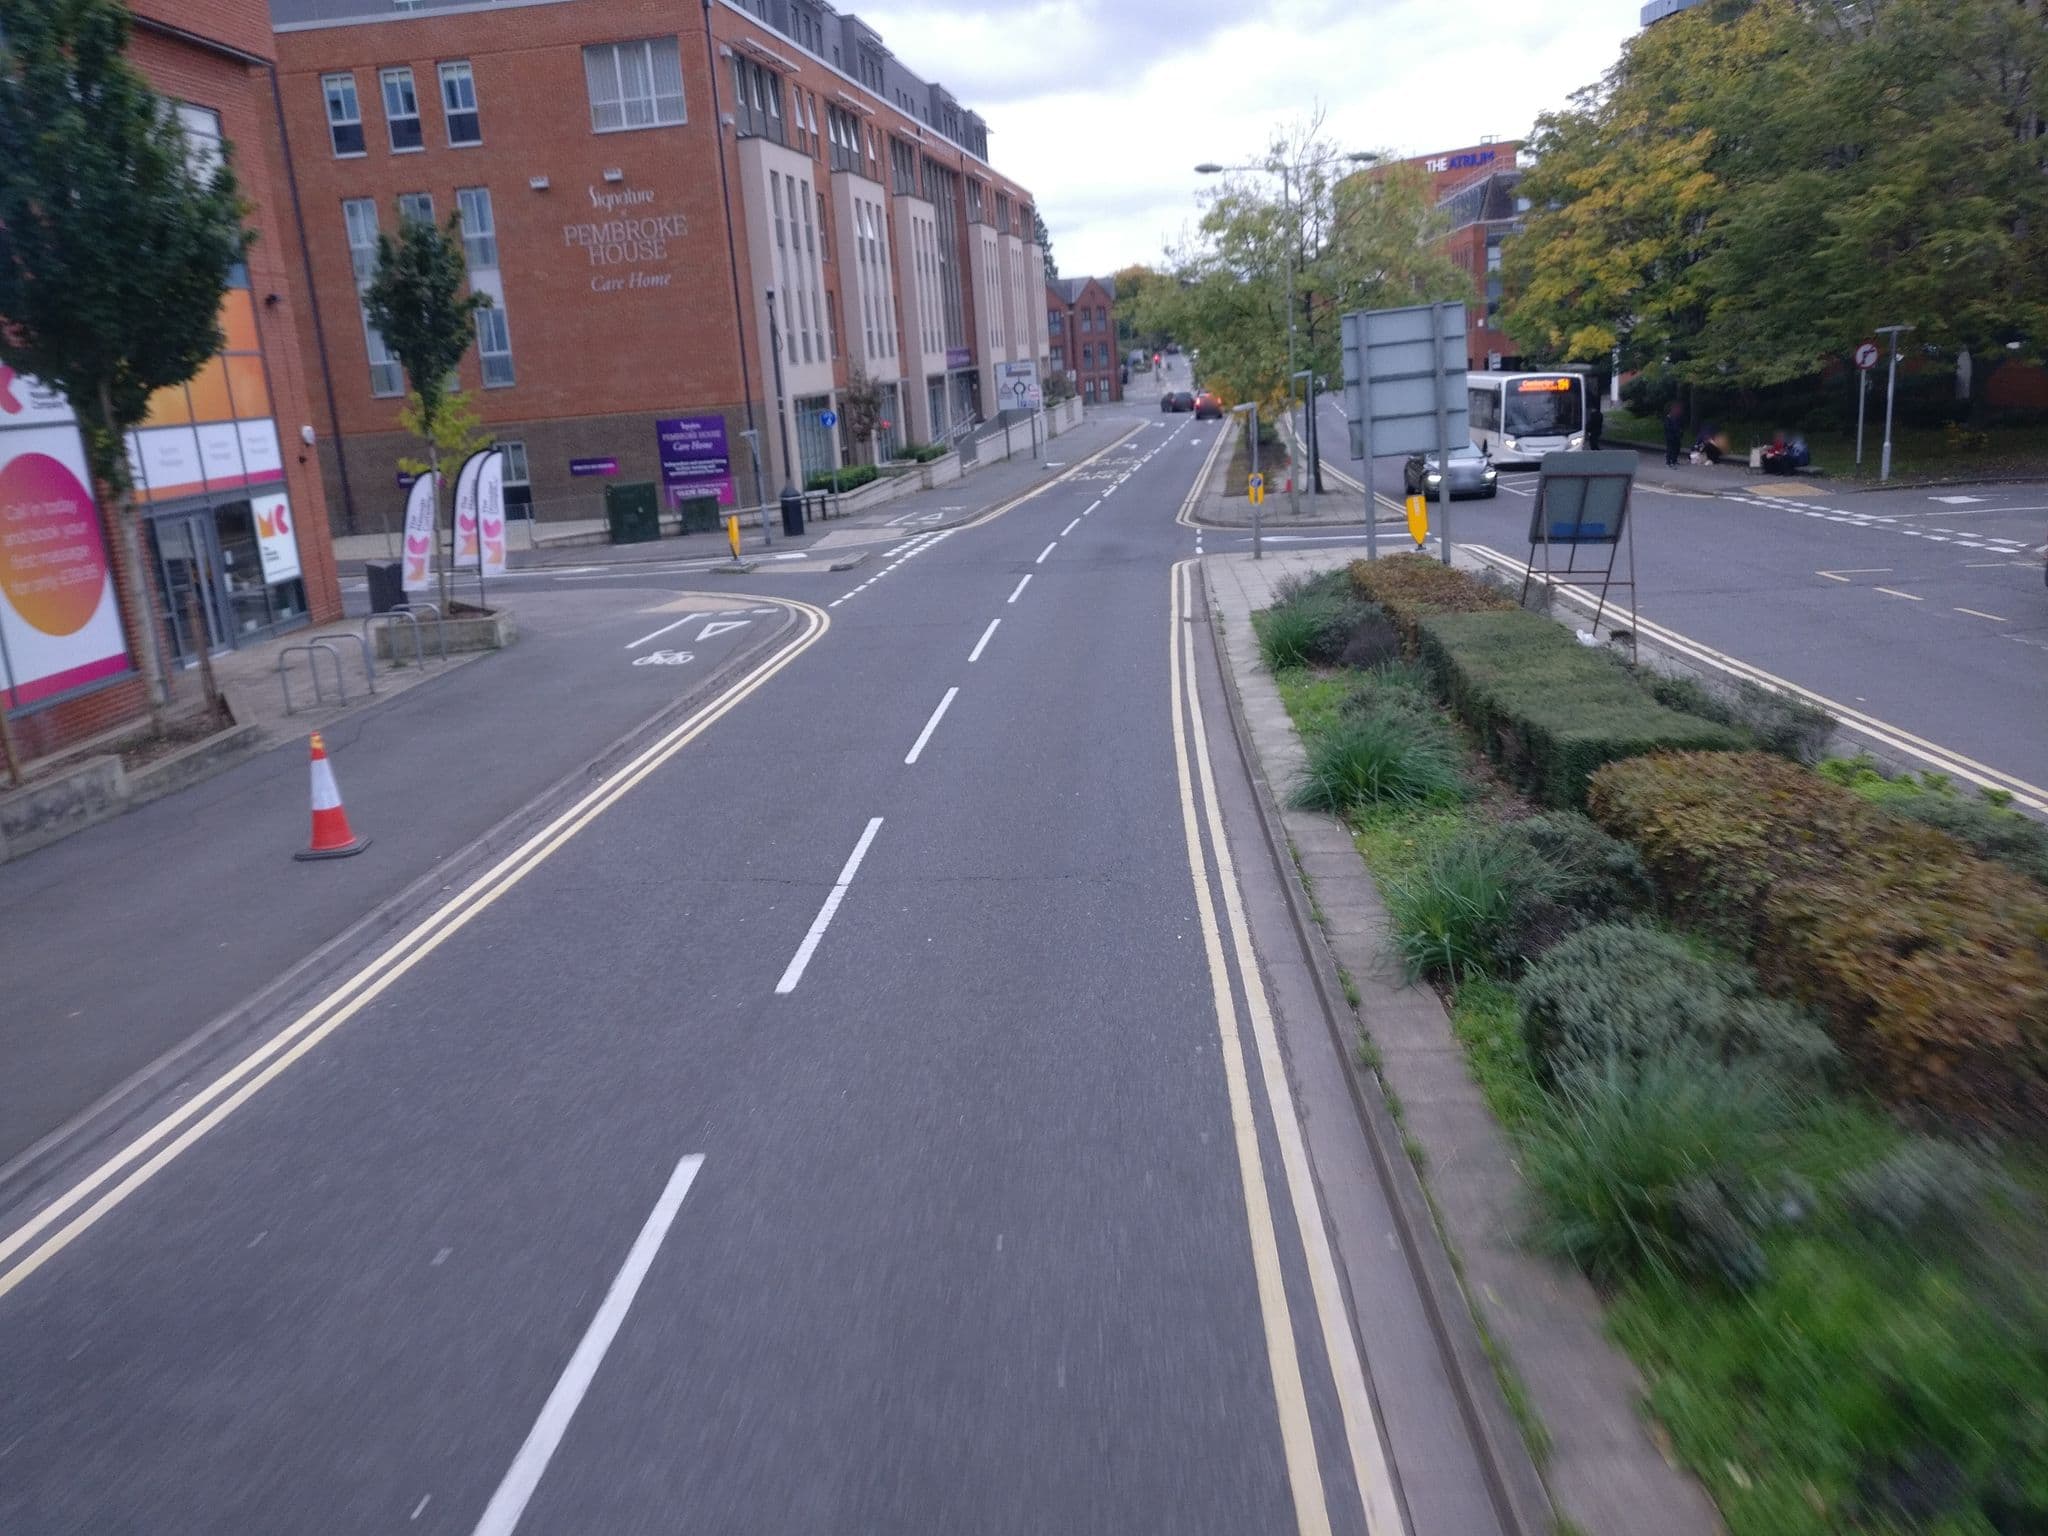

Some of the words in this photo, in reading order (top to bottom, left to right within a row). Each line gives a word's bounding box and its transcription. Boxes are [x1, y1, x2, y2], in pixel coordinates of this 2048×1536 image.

[1425, 157, 1448, 173] THE
[588, 185, 655, 212] Signature
[563, 215, 688, 247] PEMBROKE
[587, 240, 668, 266] HOUSE
[590, 275, 625, 292] Care
[629, 271, 671, 289] Home
